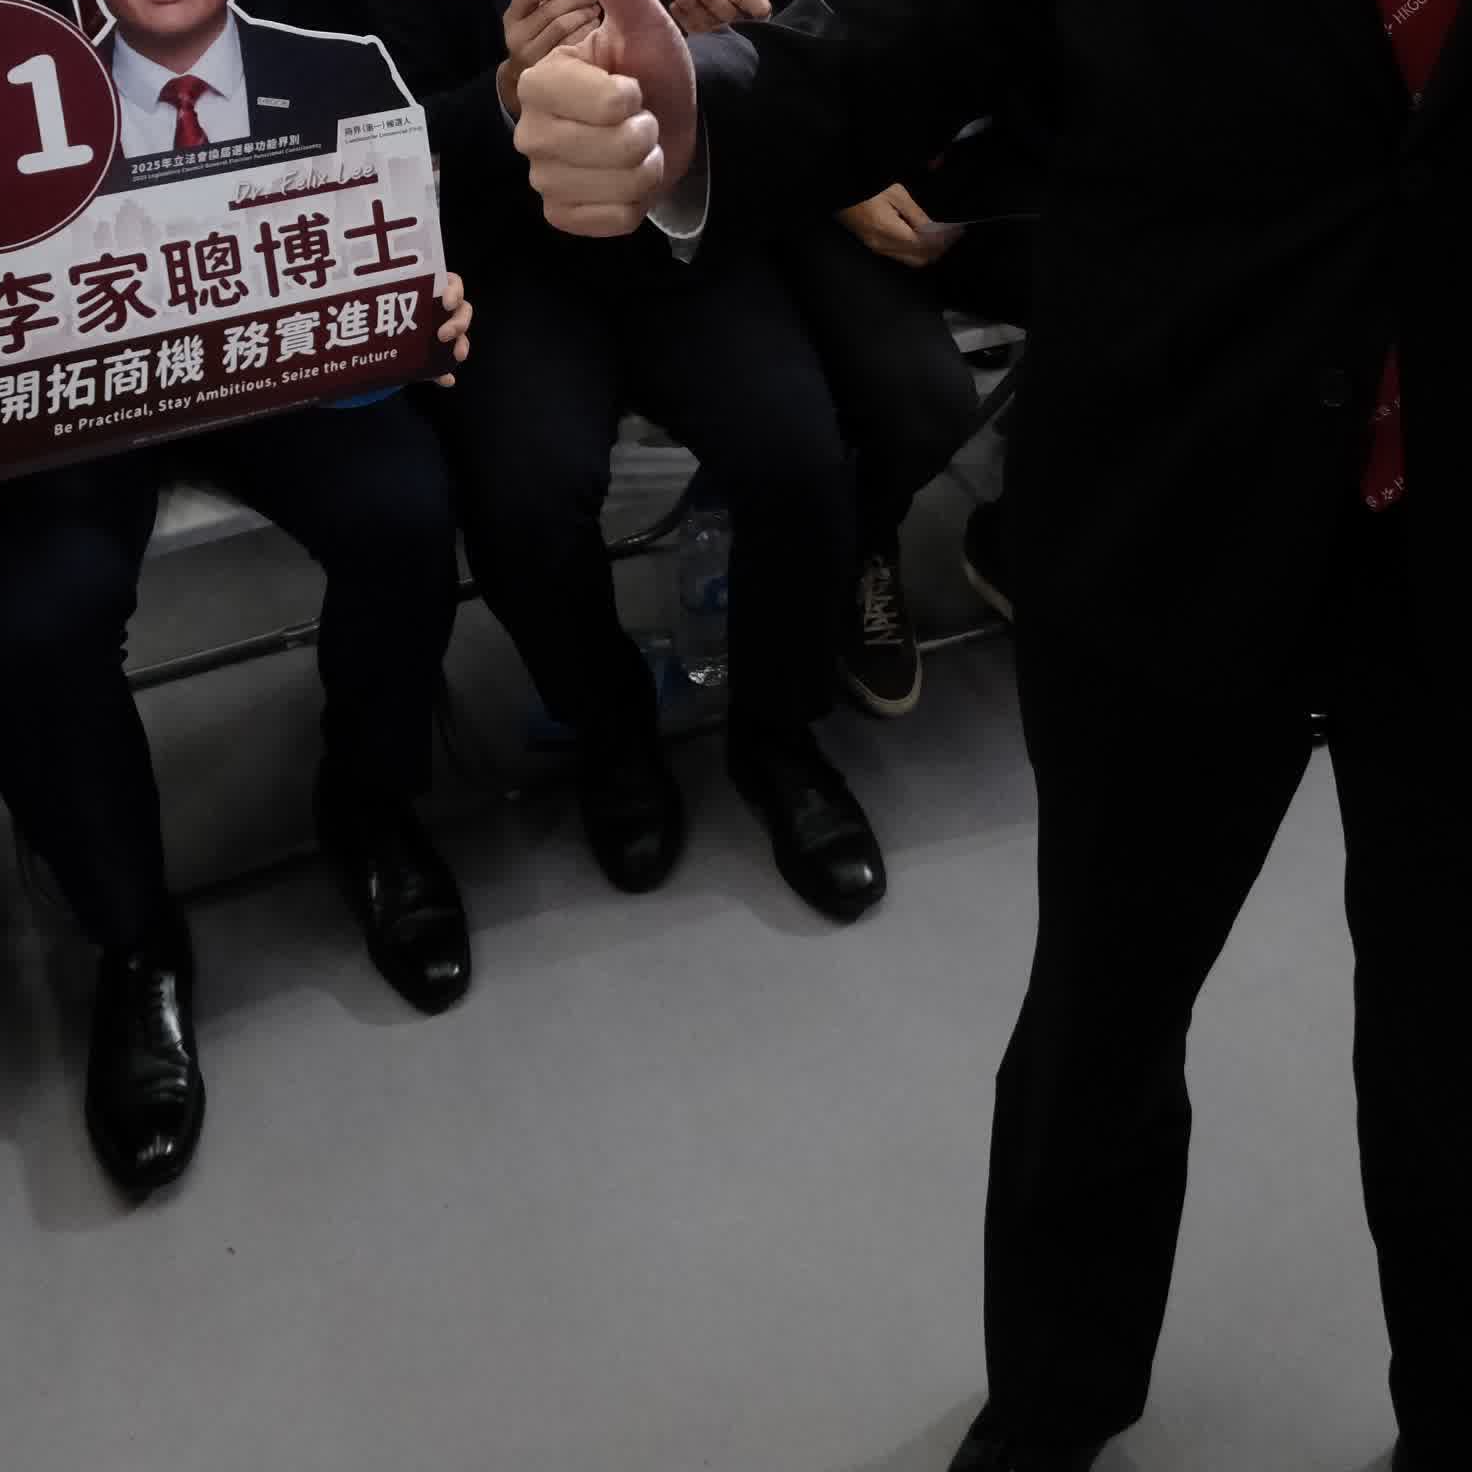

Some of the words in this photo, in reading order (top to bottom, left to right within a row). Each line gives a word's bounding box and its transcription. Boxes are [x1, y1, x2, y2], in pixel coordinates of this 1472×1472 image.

[222, 290, 420, 374] 務實進取
[54, 423, 73, 437] Be
[78, 400, 154, 431] Practical,
[158, 394, 192, 414] Stay
[196, 375, 277, 405] Ambitious,
[281, 365, 320, 384] Seize
[324, 359, 347, 374] the
[351, 347, 398, 368] Future
